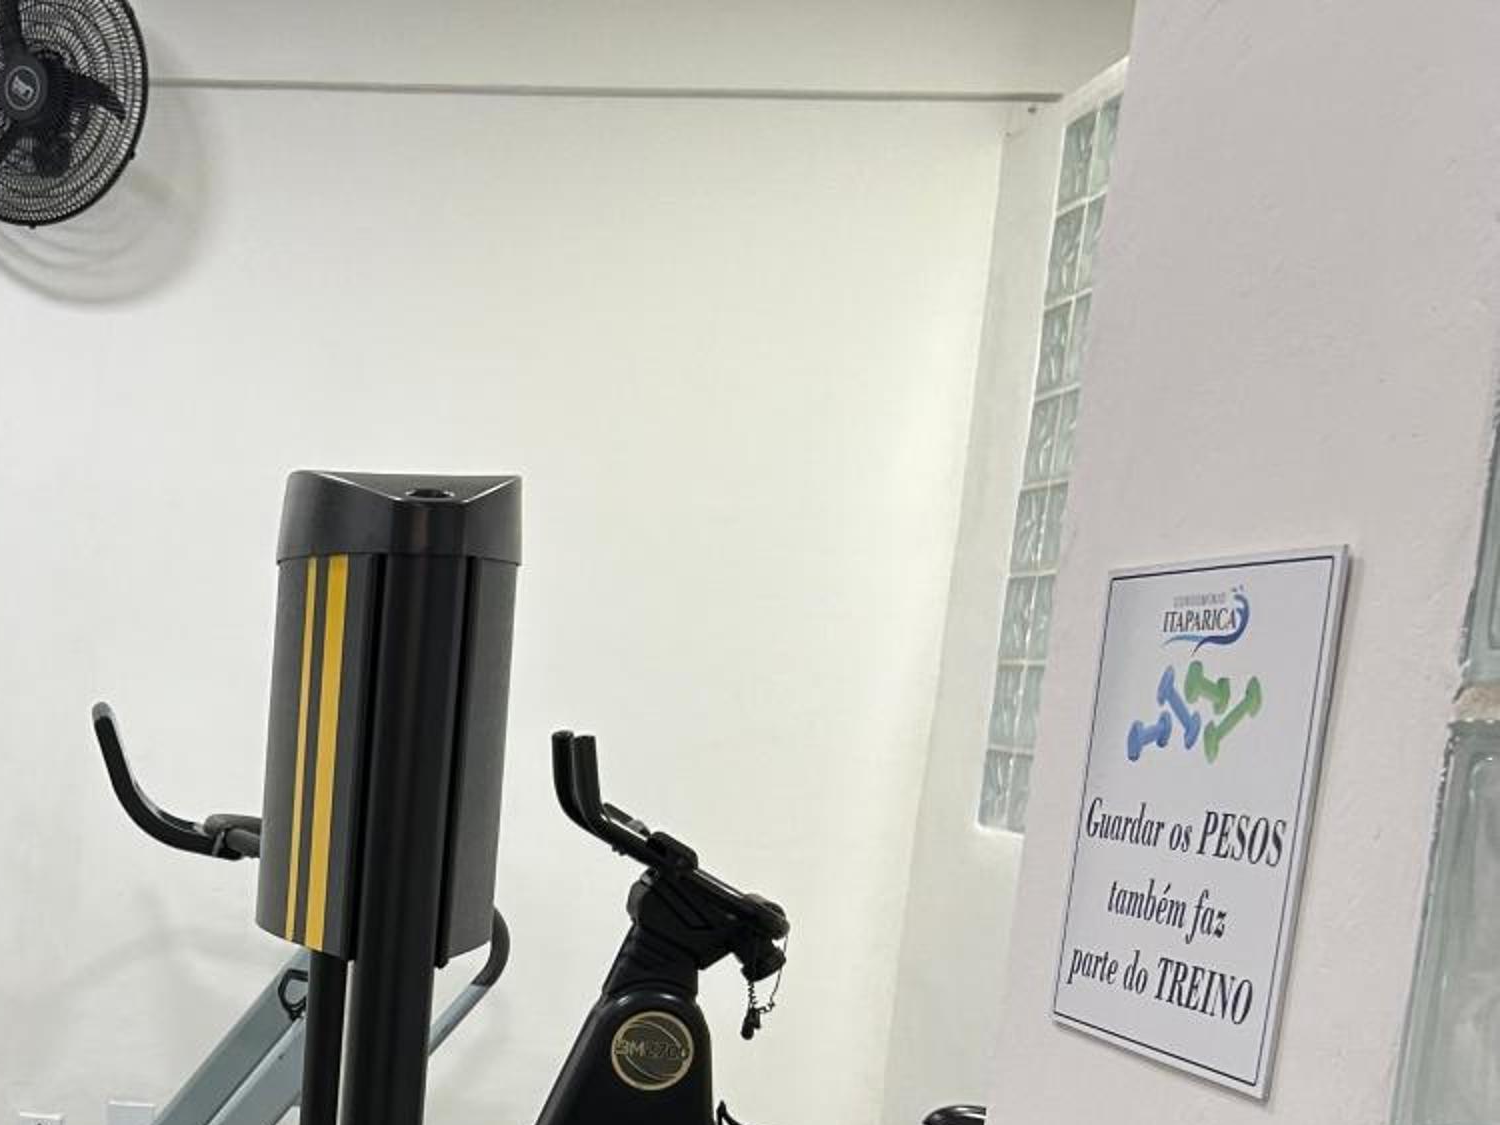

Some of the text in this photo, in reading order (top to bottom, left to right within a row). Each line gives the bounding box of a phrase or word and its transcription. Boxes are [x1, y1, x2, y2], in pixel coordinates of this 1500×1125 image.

[1163, 608, 1237, 632] ITAPARICA
[1086, 797, 1286, 867] Guardar os PESOS
[1107, 876, 1227, 944] também faz
[1066, 949, 1253, 1025] parte do TREINO
